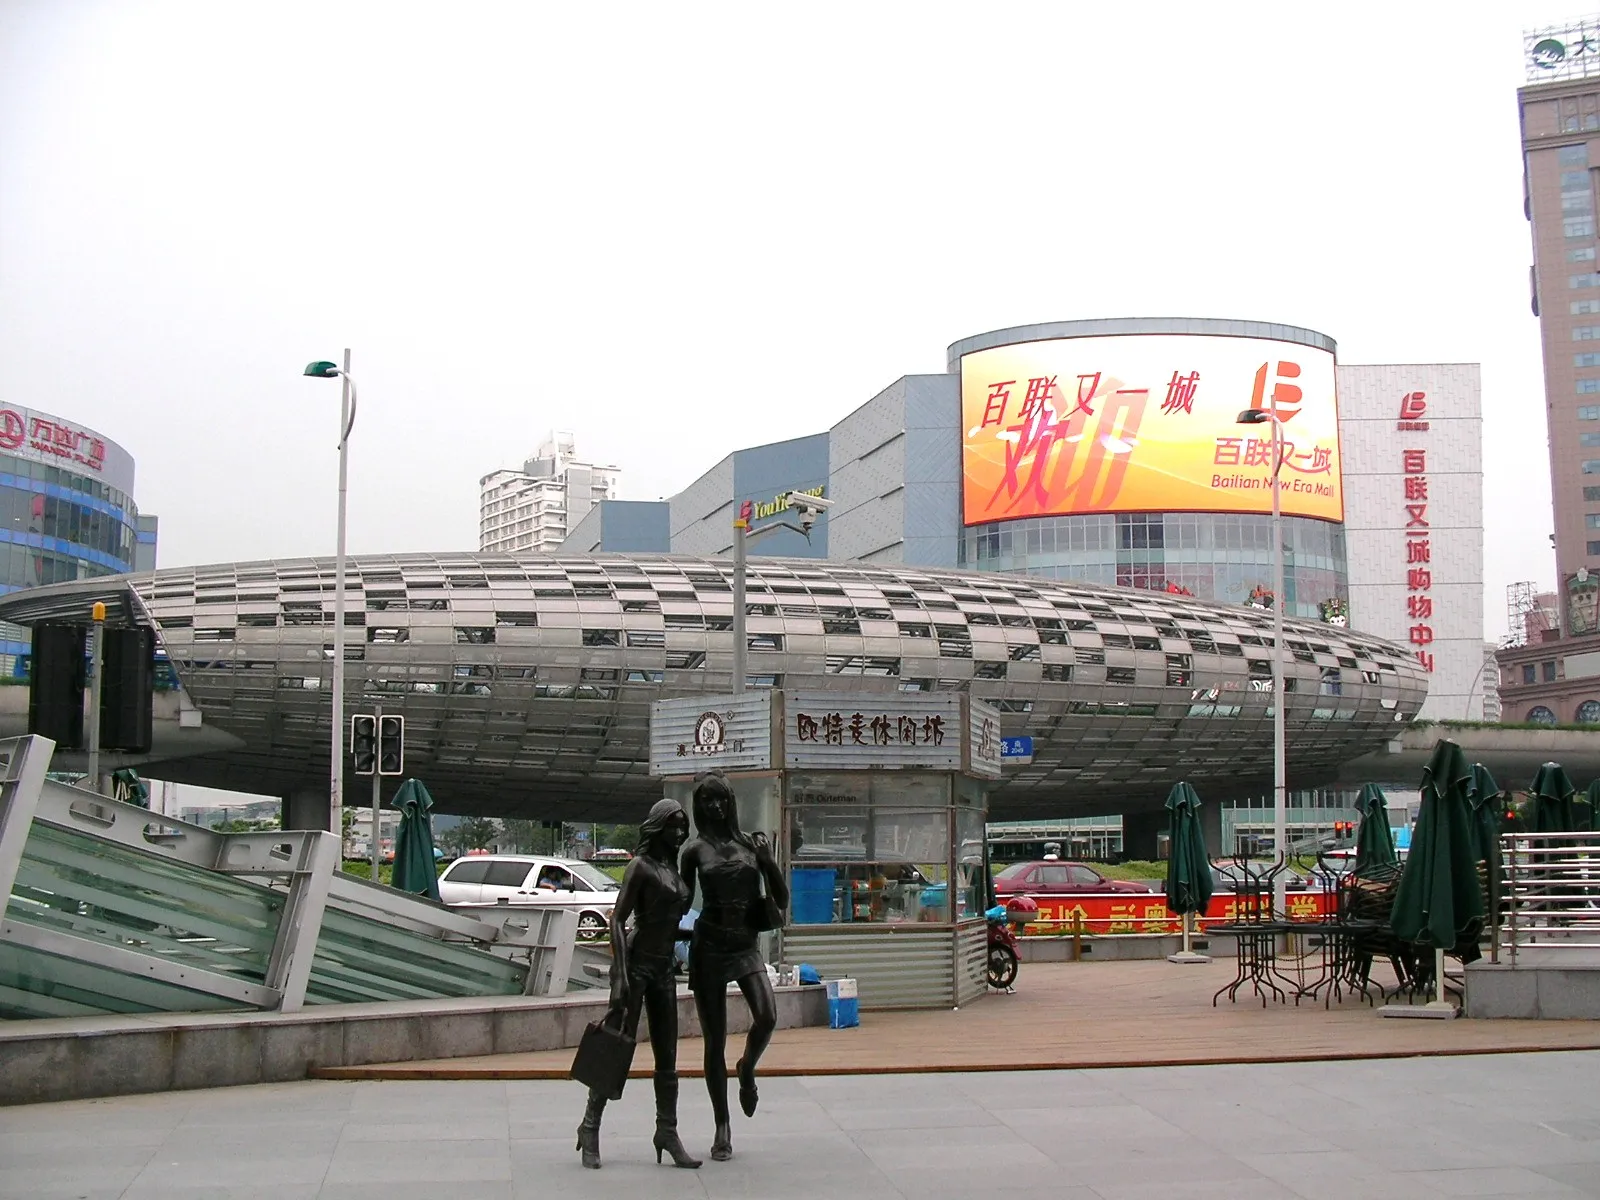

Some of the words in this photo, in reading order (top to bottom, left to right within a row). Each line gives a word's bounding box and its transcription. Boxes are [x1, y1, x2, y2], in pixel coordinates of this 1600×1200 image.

[981, 370, 1200, 428] 百联又一城
[1213, 437, 1332, 476] 百联又一城
[1211, 474, 1260, 489] Bailian
[1263, 476, 1291, 491] Nw
[1293, 478, 1312, 494] Era
[1314, 482, 1335, 498] Mall
[796, 711, 946, 747] 欧特麦休闲坊
